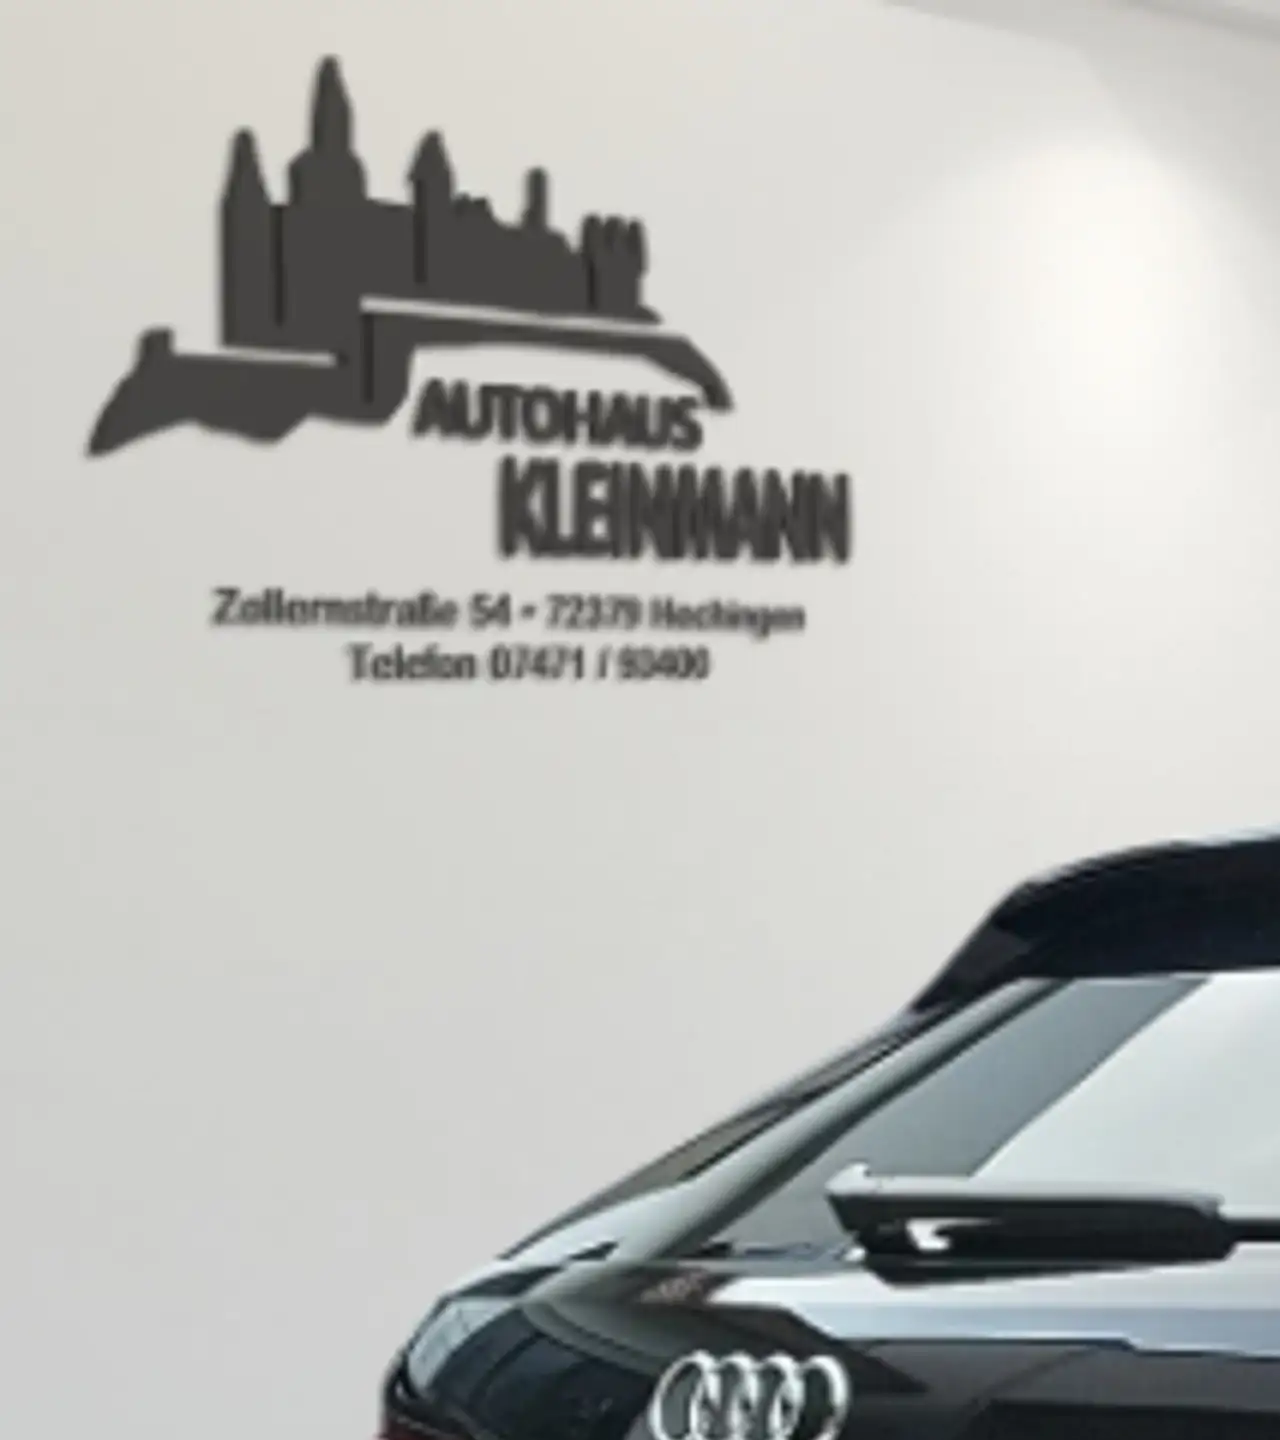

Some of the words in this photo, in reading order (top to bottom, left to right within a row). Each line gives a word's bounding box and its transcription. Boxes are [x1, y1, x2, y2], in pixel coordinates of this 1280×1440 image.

[411, 378, 703, 451] AUTOHAUS
[498, 454, 850, 562] KLEINMANN
[468, 590, 513, 630] 54
[546, 592, 643, 631] 72379
[649, 595, 808, 641] Hechingen
[344, 641, 478, 682] Telefon
[488, 642, 586, 682] 07471
